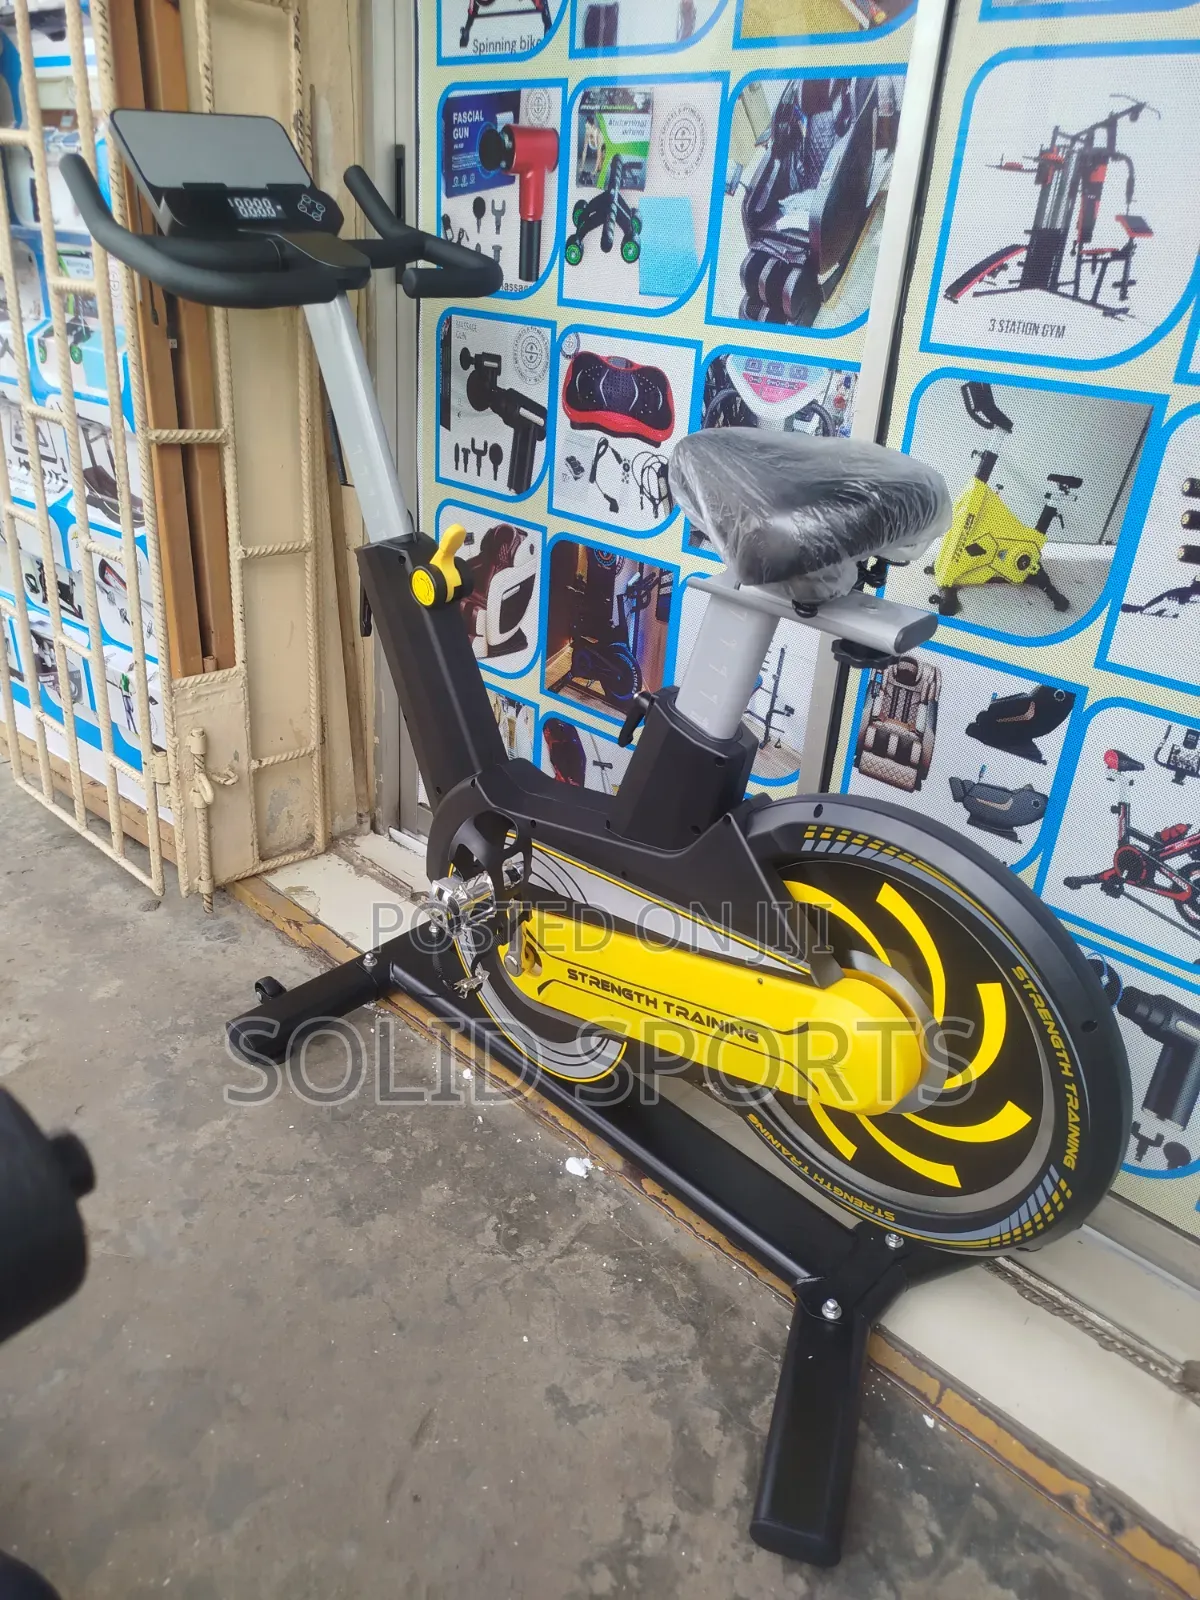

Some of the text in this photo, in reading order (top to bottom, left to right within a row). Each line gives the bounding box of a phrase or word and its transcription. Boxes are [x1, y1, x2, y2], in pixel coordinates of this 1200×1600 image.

[472, 38, 517, 55] Spinning
[452, 110, 484, 124] FASCIAL
[452, 127, 470, 140] GUN
[988, 318, 1066, 339] 3 STATION GYM
[567, 968, 759, 1044] STRENGTH TRAINING
[1011, 965, 1081, 1171] STRENGTH TRAINING
[746, 1113, 896, 1222] STRENGTH TRAINING
